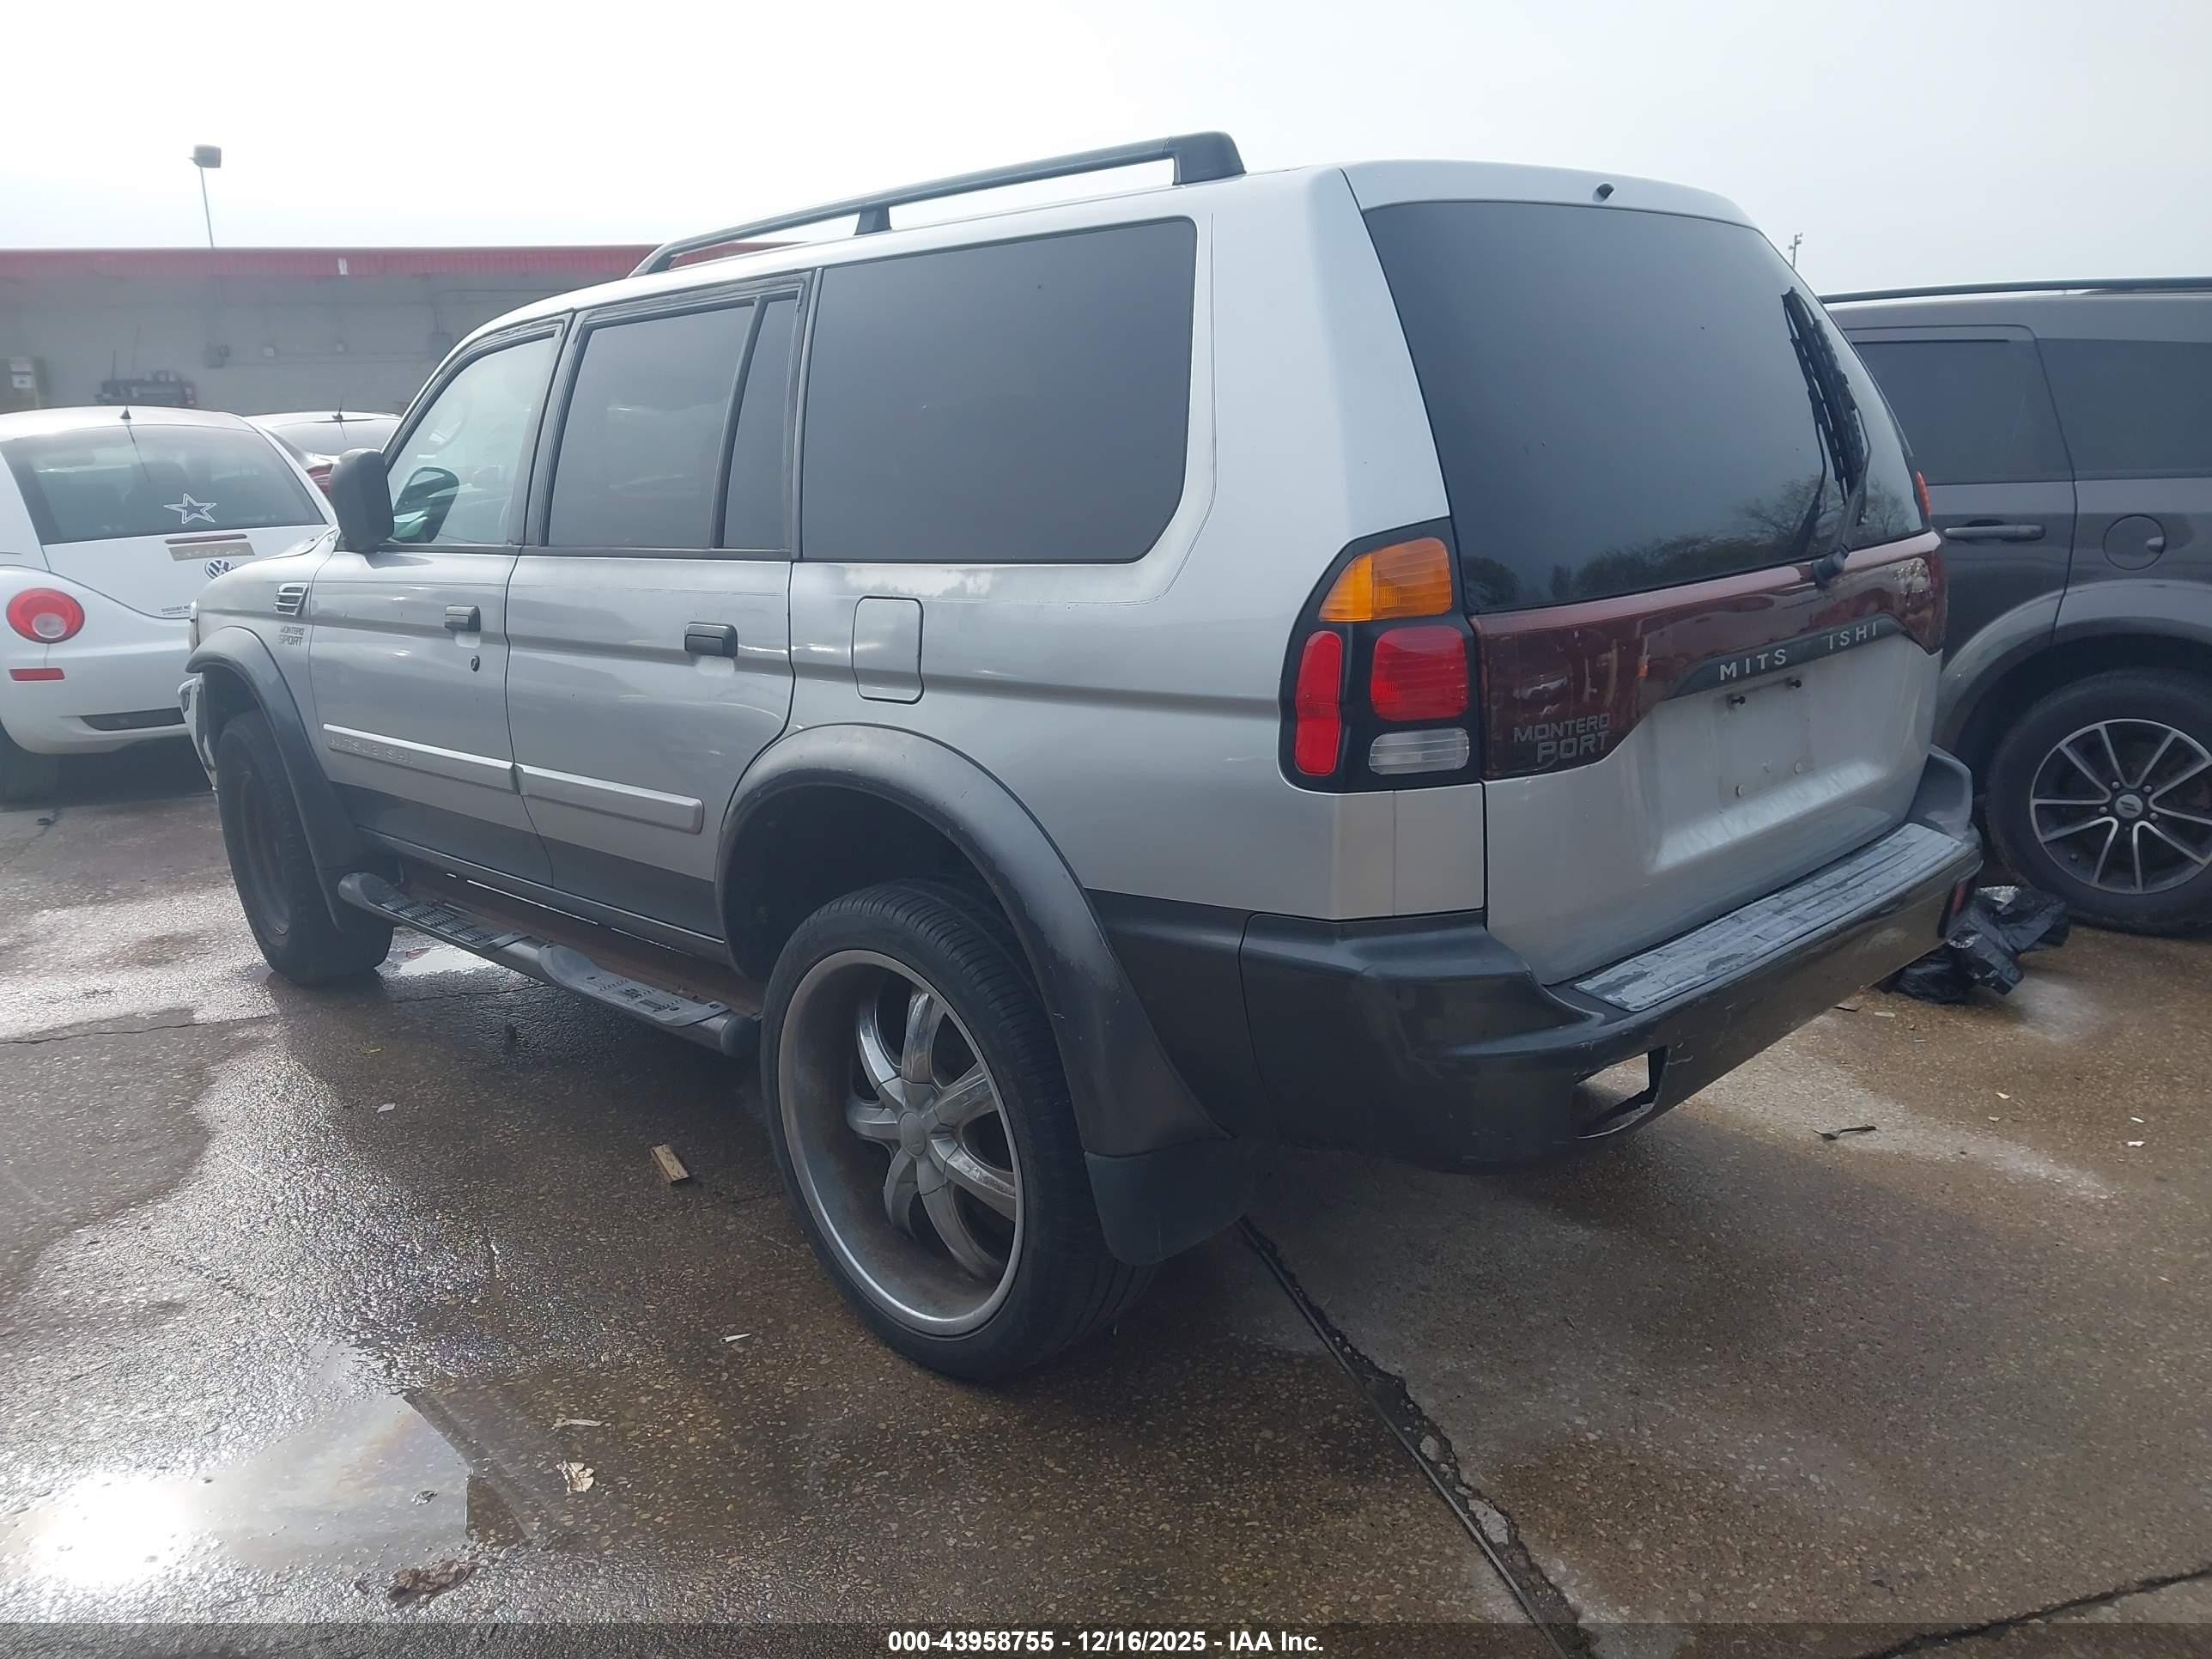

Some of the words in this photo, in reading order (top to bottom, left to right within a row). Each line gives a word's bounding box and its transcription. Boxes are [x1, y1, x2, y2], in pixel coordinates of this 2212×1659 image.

[280, 625, 305, 635] MONTERO
[277, 635, 303, 647] SPORT
[1513, 713, 1610, 743] MONTERO
[1536, 731, 1610, 763] PORT
